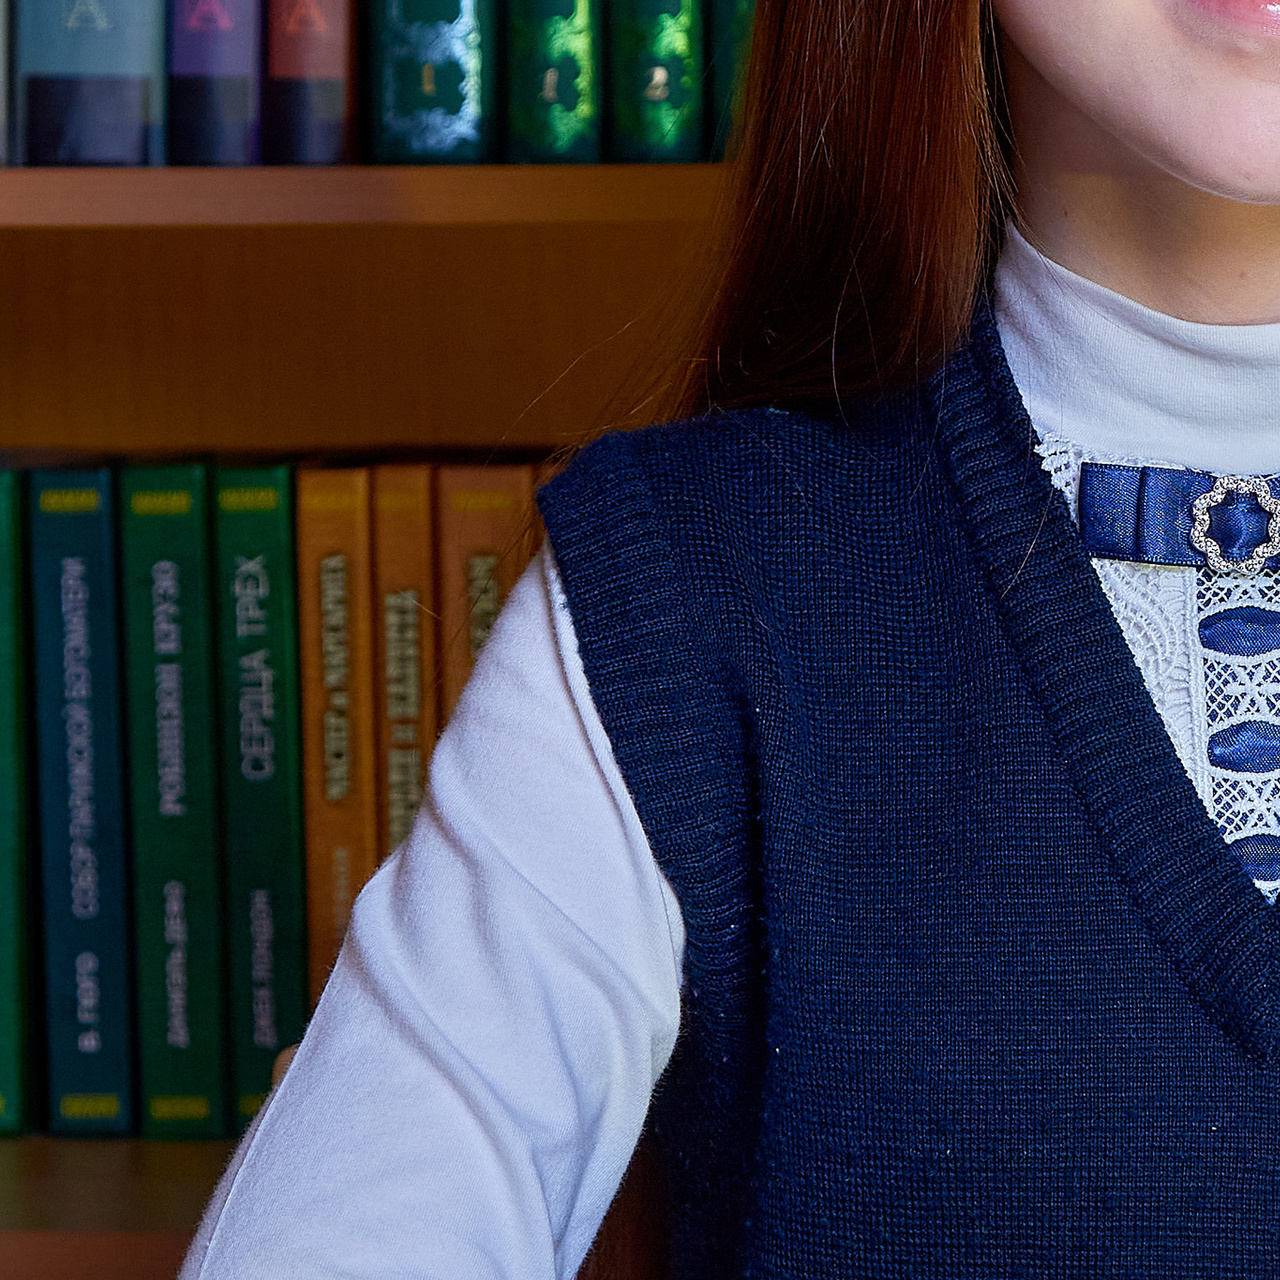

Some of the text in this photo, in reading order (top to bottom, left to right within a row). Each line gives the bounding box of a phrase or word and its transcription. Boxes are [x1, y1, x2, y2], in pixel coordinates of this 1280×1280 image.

[60, 556, 93, 700] БОГОМАТЕРИ
[151, 560, 182, 655] КРУЗО
[61, 703, 97, 836] ПАРИЖСКОЙ
[155, 663, 188, 817] РОБИНЗОН
[238, 648, 276, 781] СЕРДЦА
[70, 841, 99, 919] СОБОР
[250, 889, 275, 983] ЛОНДОН
[74, 951, 100, 1025] ГЮГО
